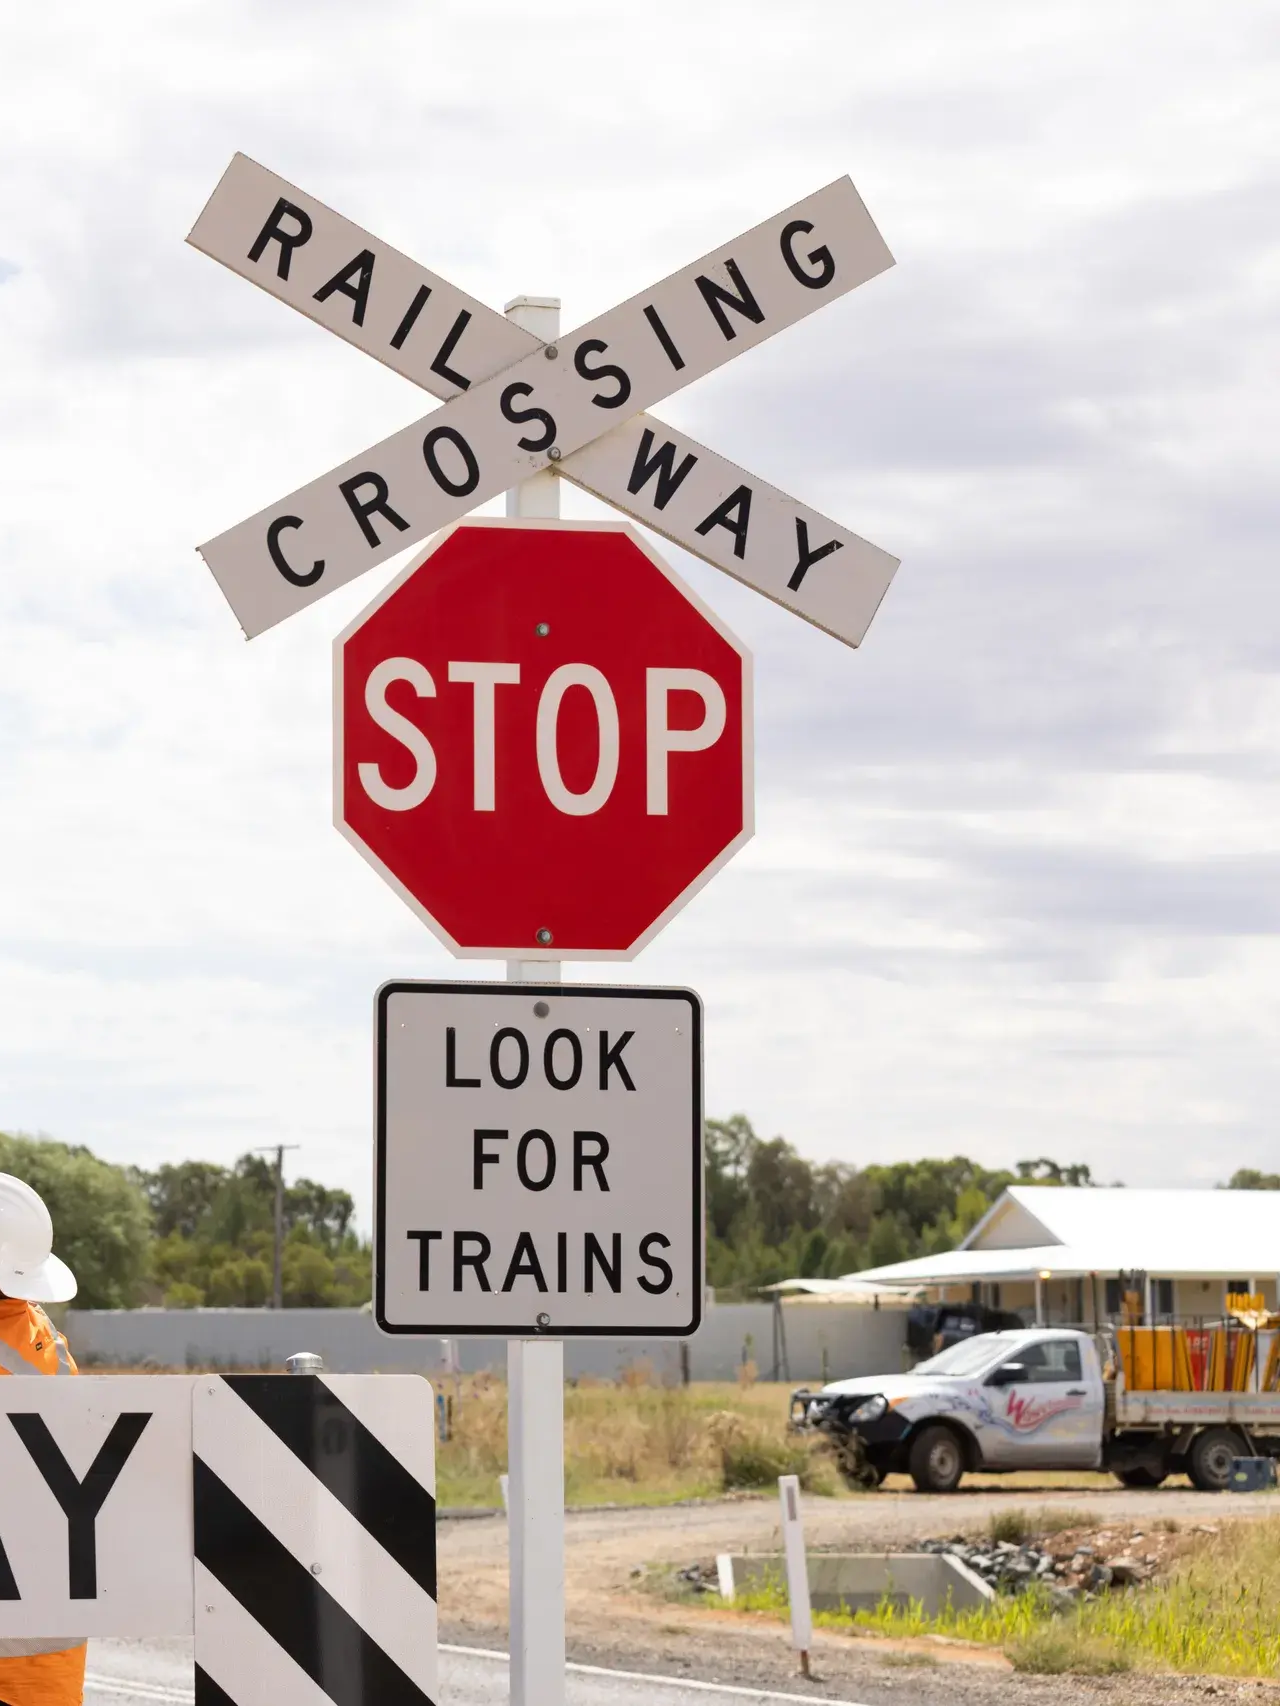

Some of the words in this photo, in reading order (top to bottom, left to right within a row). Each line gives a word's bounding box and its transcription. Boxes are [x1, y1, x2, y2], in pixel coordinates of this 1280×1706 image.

[247, 197, 472, 391] RAIL
[626, 427, 844, 592] WAY
[266, 219, 836, 588] CROSSING
[357, 656, 727, 817] STOP
[445, 1026, 637, 1092] LOOK
[472, 1128, 611, 1192] FOR
[407, 1230, 674, 1296] TRAINS
